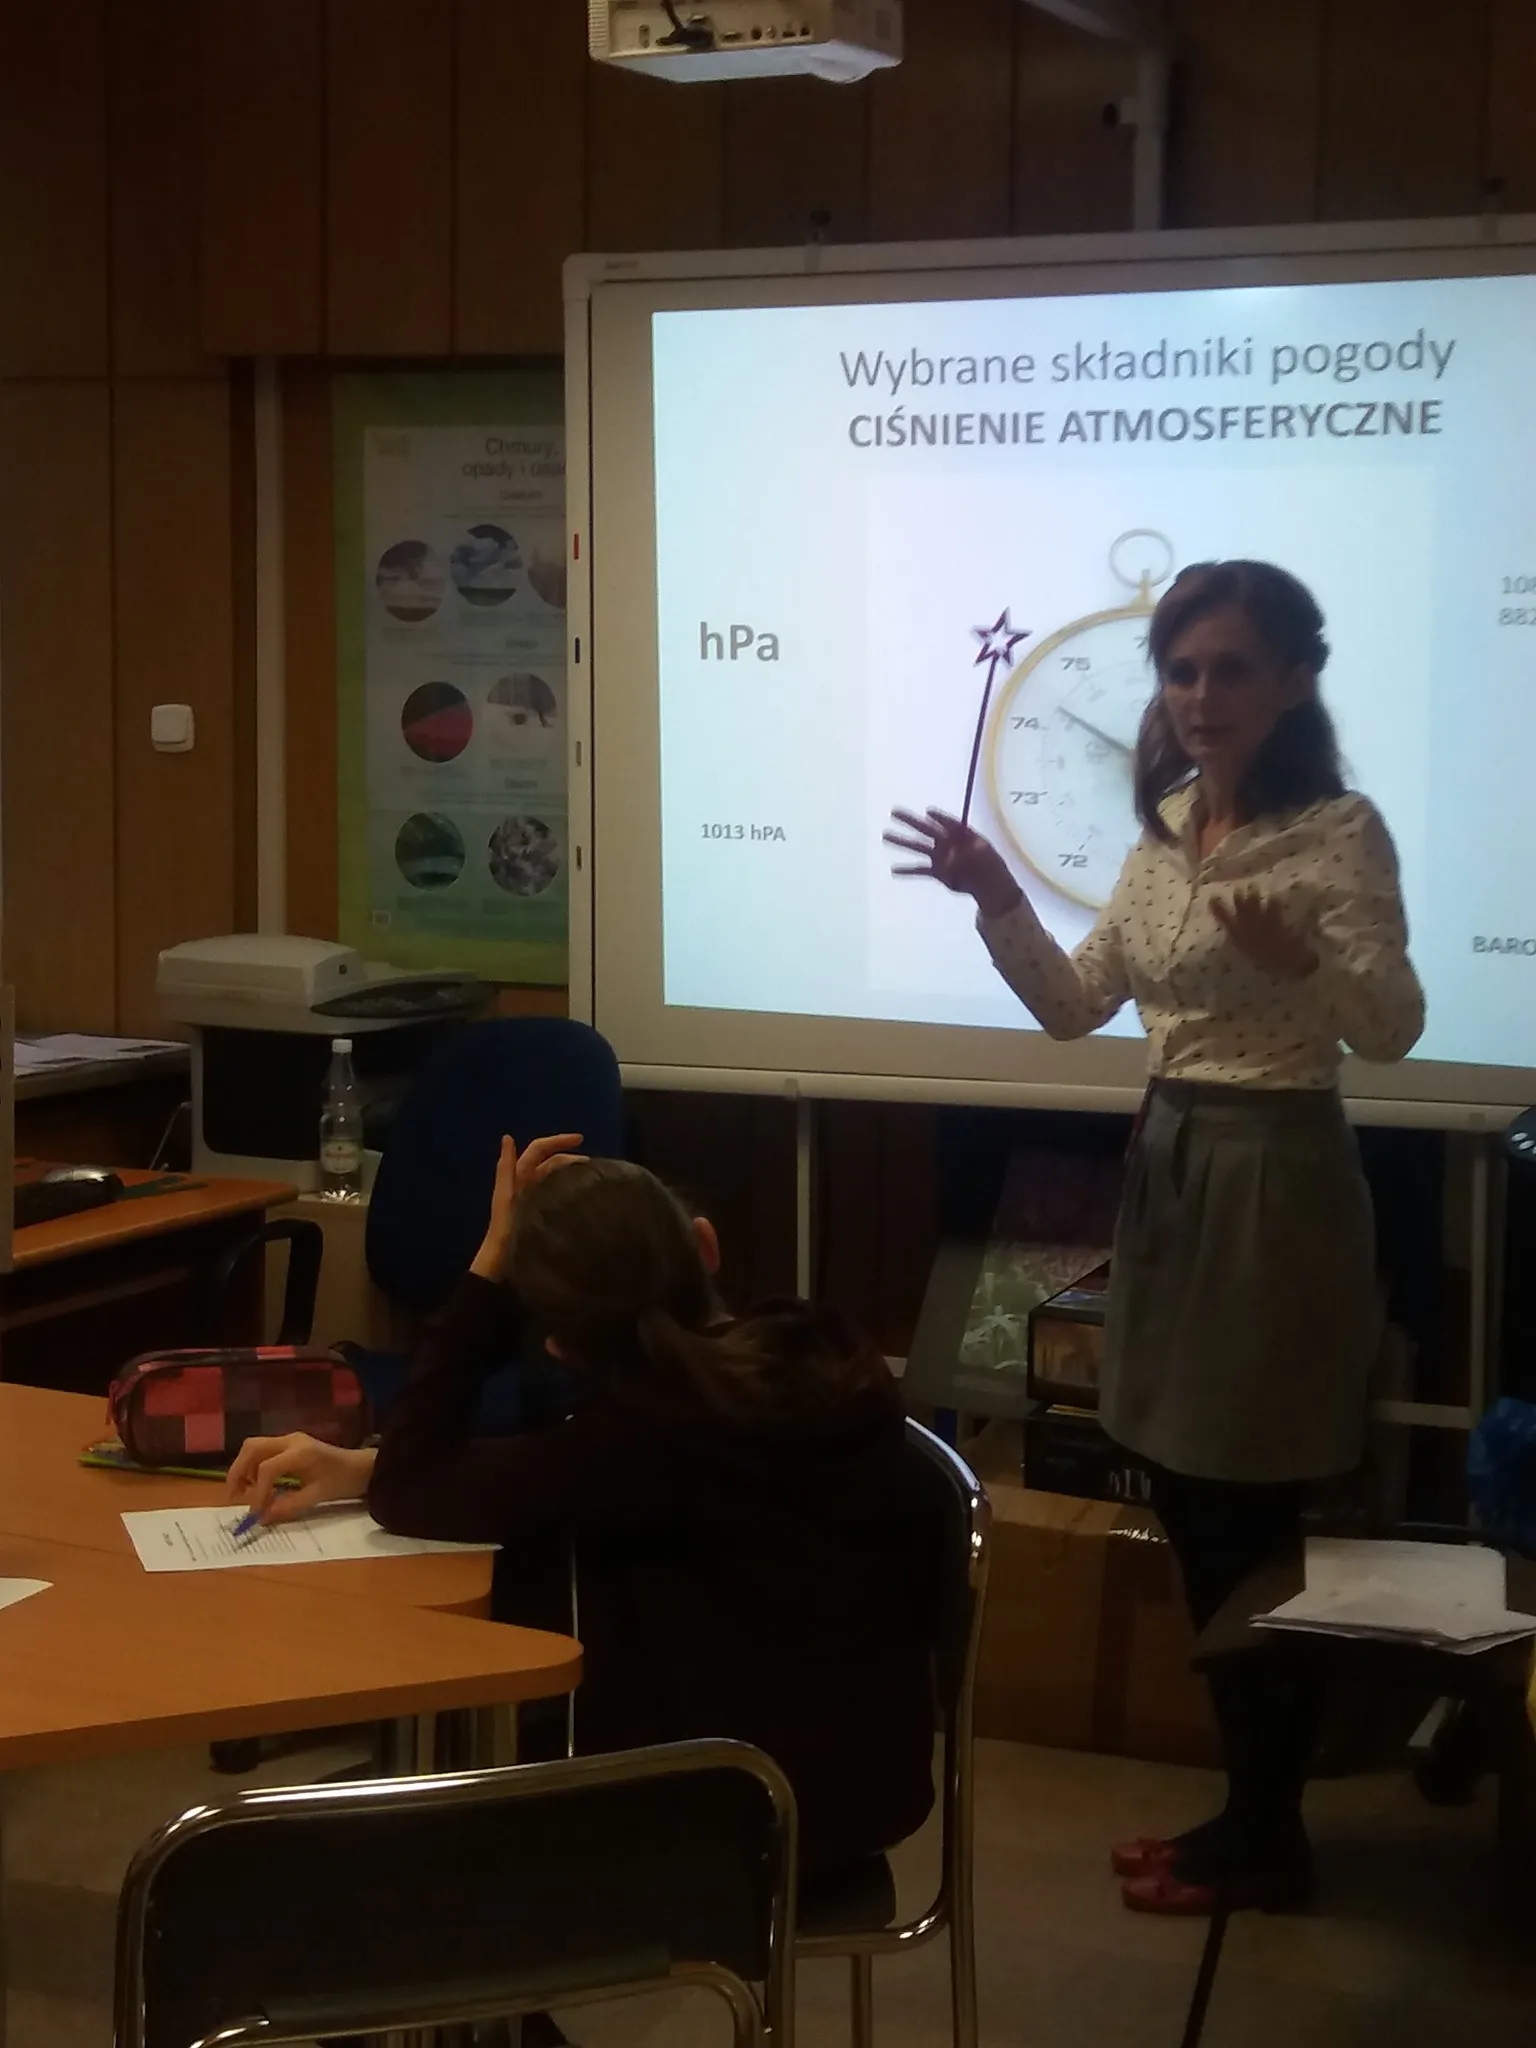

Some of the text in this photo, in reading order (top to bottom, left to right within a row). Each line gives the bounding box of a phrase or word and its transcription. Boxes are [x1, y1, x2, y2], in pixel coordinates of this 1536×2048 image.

[839, 328, 1457, 397] Wybrane składniki pogody
[848, 400, 1443, 448] CIŚNIENIE ATMOSFERYCZNE
[700, 621, 779, 661] hPa
[1060, 656, 1091, 672] 75
[1011, 716, 1040, 731] 74
[1010, 791, 1039, 805] 73
[701, 823, 787, 842] 1013 hPA
[1058, 853, 1089, 868] 72
[1472, 935, 1536, 957] BARO
